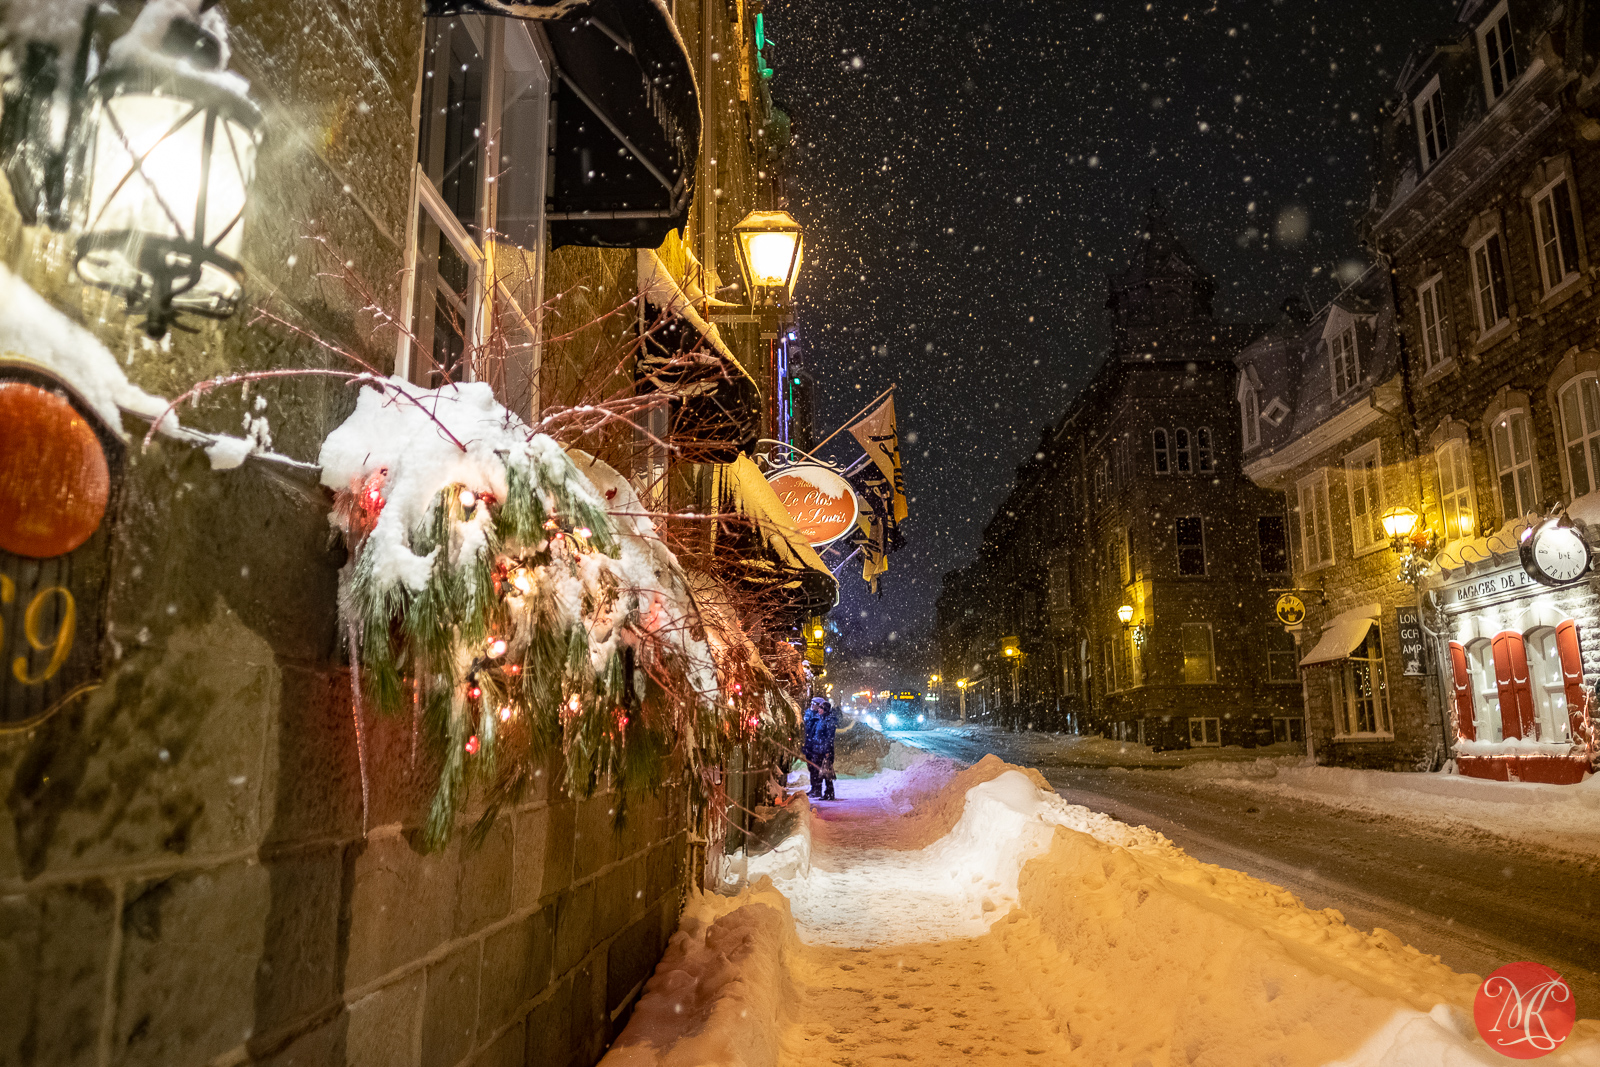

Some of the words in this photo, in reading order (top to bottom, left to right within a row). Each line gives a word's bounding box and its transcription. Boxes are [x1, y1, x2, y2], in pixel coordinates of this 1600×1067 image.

[780, 490, 799, 507] Le
[802, 490, 832, 507] Clos
[1457, 579, 1497, 600] BAGAGES
[1399, 614, 1417, 624] LON
[1401, 629, 1420, 639] GCH
[1403, 644, 1422, 655] AMP
